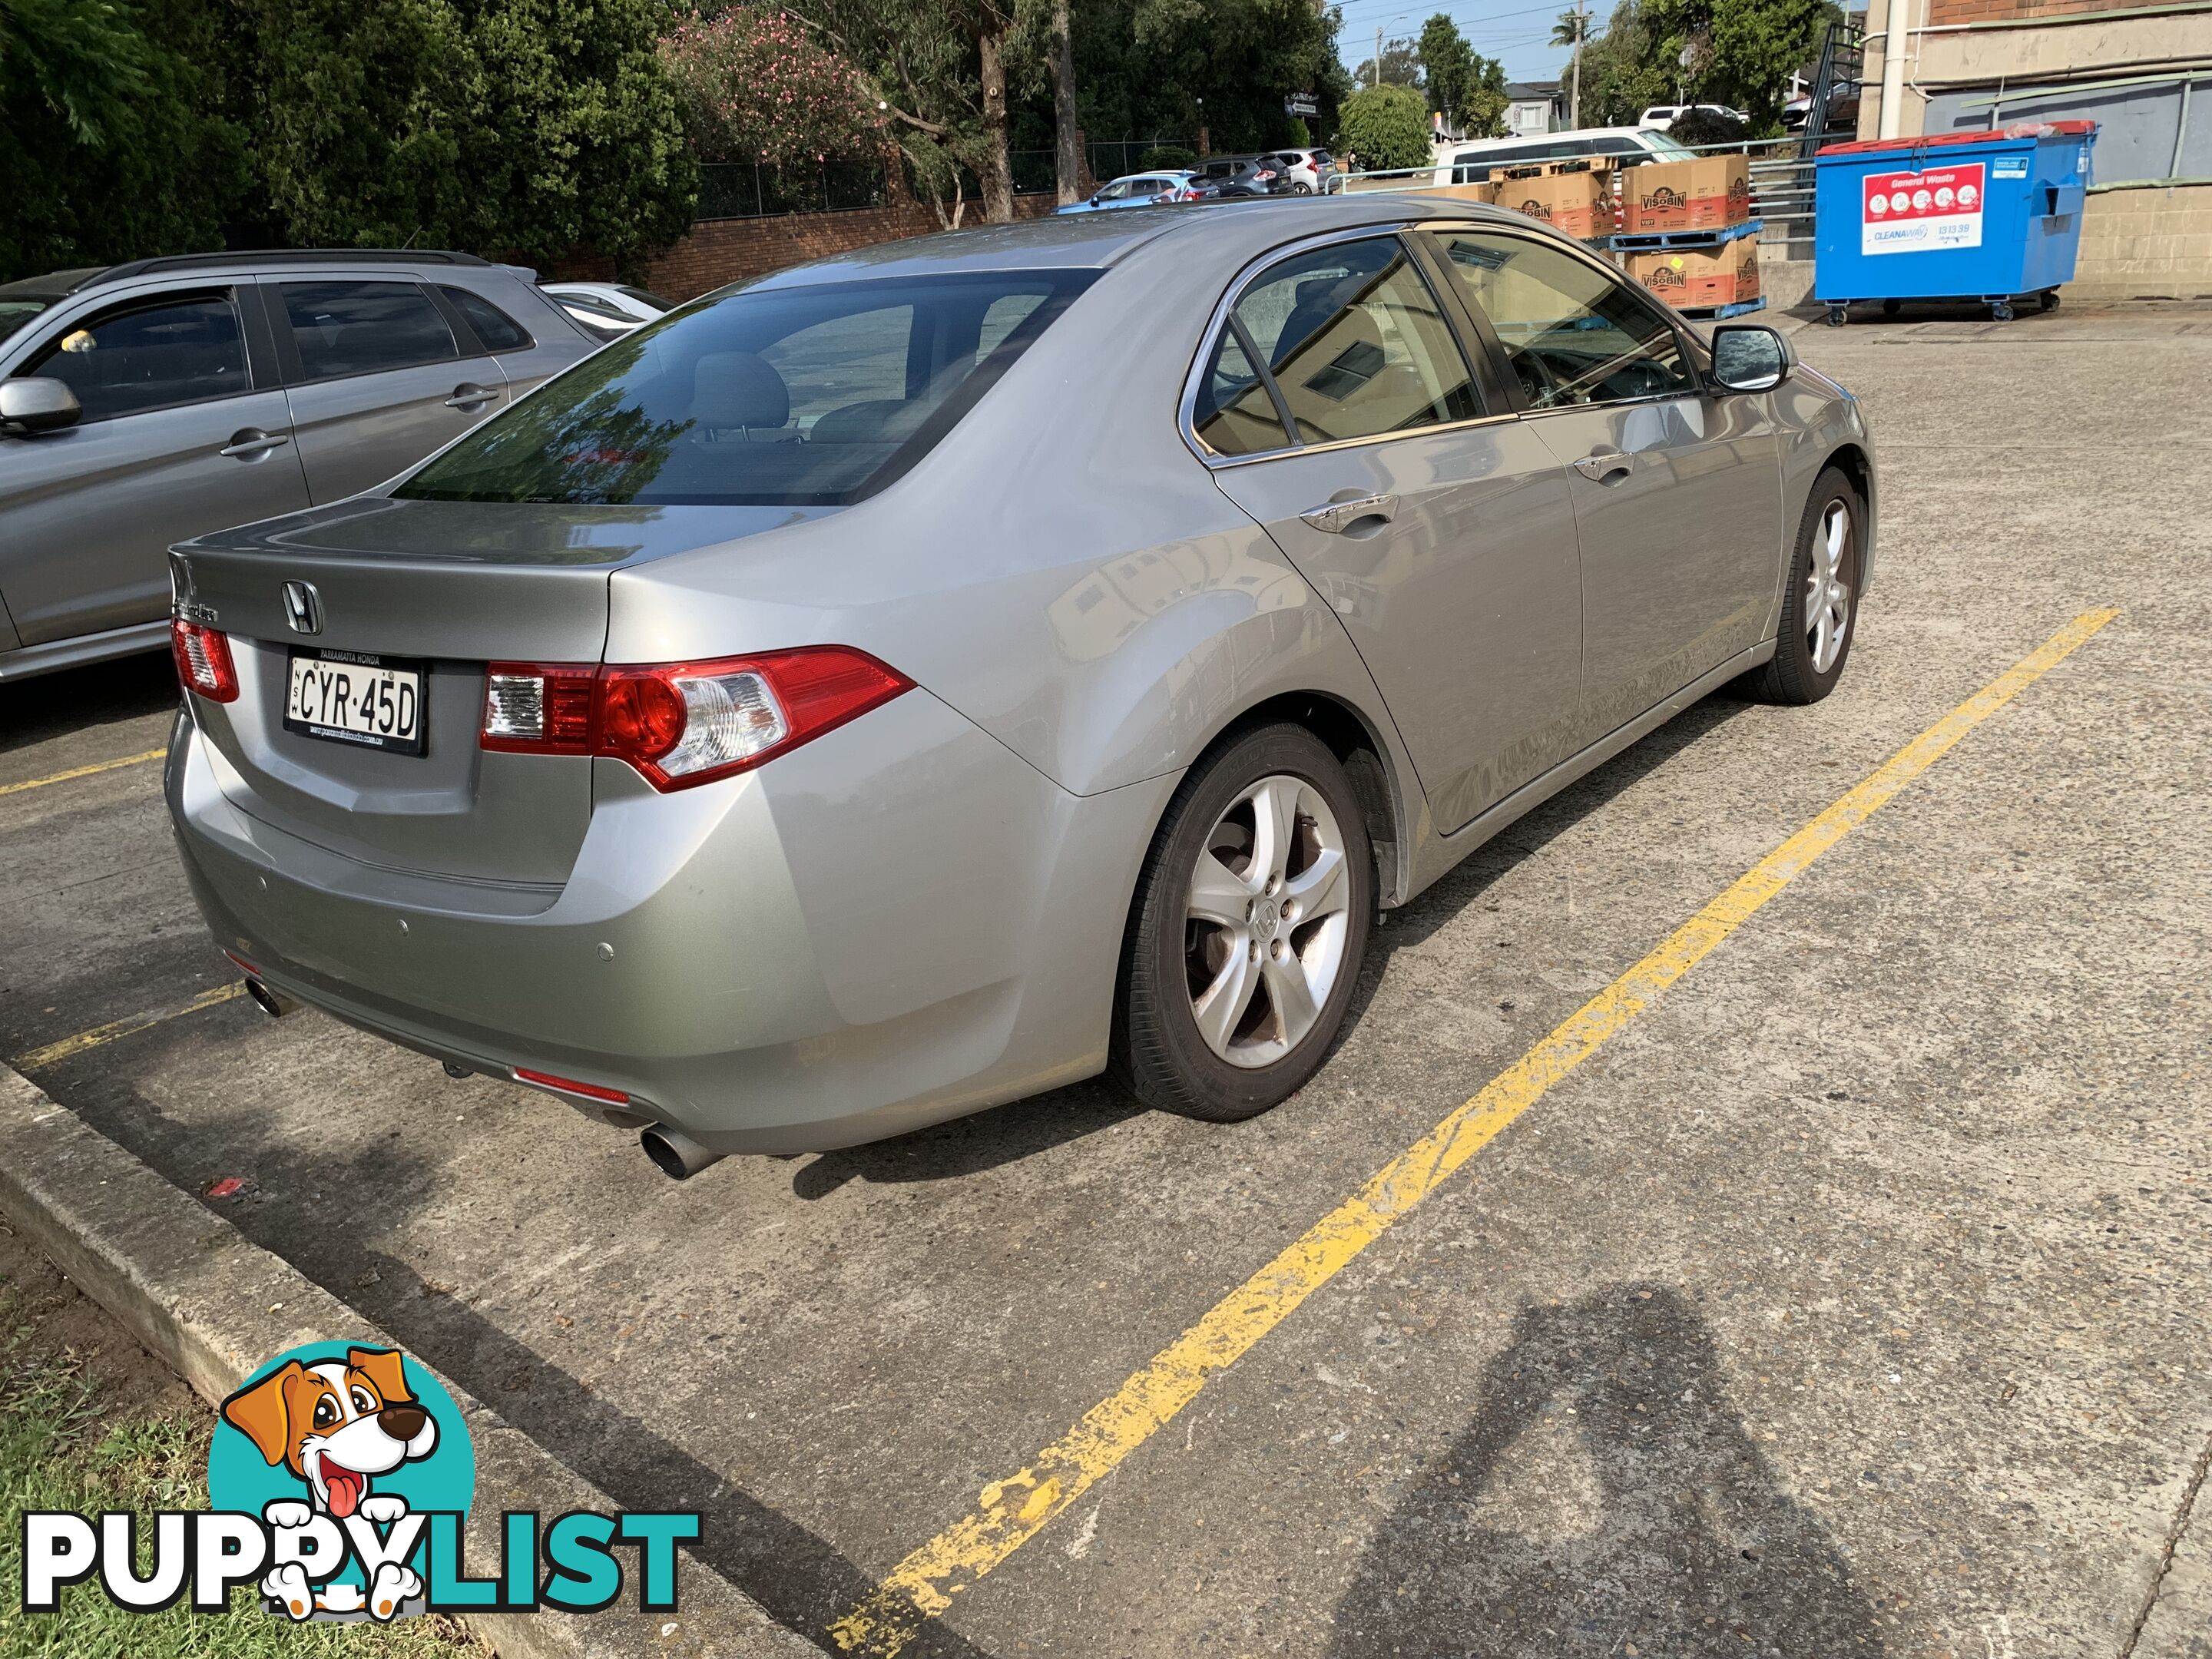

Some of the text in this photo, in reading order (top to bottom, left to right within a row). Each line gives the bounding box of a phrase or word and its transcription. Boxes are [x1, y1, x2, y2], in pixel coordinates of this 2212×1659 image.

[1891, 174, 1955, 188] General Waste
[1643, 194, 1684, 209] VISOBIN
[1874, 225, 1925, 240] CLEANAWAY
[1644, 273, 1685, 286] VISOBIN
[320, 649, 380, 666] PARRAMATTA HONDA
